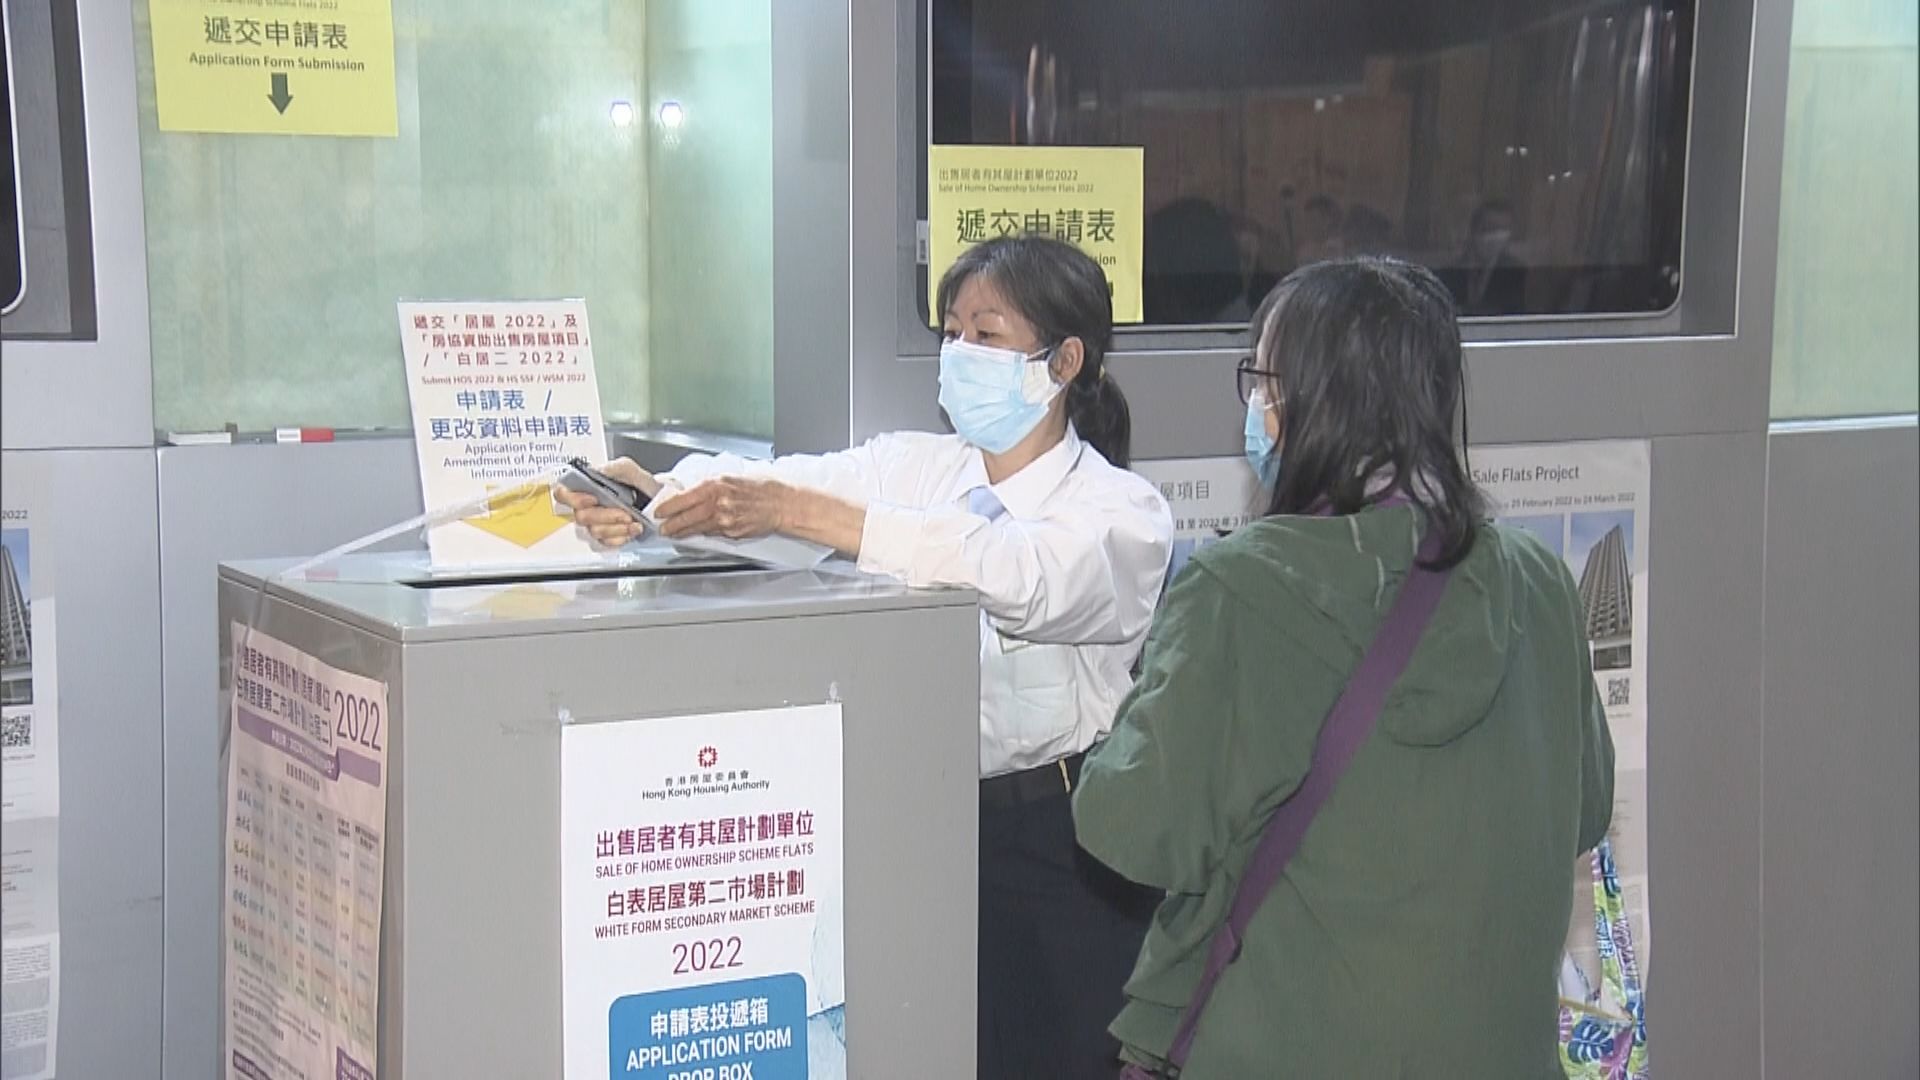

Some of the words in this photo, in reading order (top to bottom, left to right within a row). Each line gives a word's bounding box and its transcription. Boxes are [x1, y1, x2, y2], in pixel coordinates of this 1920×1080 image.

[319, 1, 339, 10] 2022
[204, 15, 348, 49] 遞交申請表
[189, 52, 260, 67] Application
[264, 56, 295, 68] Form
[298, 57, 365, 71] Submission
[957, 208, 1116, 243] 遞交申請表
[421, 374, 450, 385] Submit
[475, 374, 494, 384] 2022
[543, 374, 564, 384] WSM
[567, 374, 586, 383] 2022
[456, 389, 525, 412] 申請表
[544, 389, 552, 412] /
[430, 416, 592, 441] 更改資料申請表
[443, 455, 511, 468] Amendment
[514, 454, 524, 465] of
[465, 443, 526, 456] Application
[529, 442, 556, 452] Form
[471, 468, 534, 480] Information
[1473, 468, 1499, 484] Sale
[1502, 466, 1532, 482] Flats
[1536, 464, 1579, 482] Project
[1152, 480, 1210, 501] 屋項目
[335, 690, 381, 752] 2022
[642, 789, 666, 800] Hong
[668, 787, 691, 798] Kong
[693, 783, 729, 795] Housing
[731, 780, 770, 791] Authority
[595, 809, 814, 859] 出售居者有其屋計劃單位
[595, 864, 623, 879] SALE
[625, 862, 640, 875] OF
[641, 858, 673, 873] HOME
[675, 852, 737, 869] OWNERSHIP
[739, 846, 781, 862] SCHEME
[783, 842, 814, 858] FLATS
[607, 868, 805, 918] 白表居屋第二市場計劃
[594, 923, 629, 939] WHITE
[631, 920, 662, 935] FORM
[664, 912, 726, 931] SECONDARY
[729, 905, 771, 922] MARKET
[774, 900, 816, 917] SCHEME
[672, 936, 744, 976] 2022
[651, 997, 769, 1040] 申請表投遞箱
[626, 1034, 740, 1072] APPLICATION
[744, 1026, 792, 1054] FORM
[719, 1061, 754, 1080] BOX
